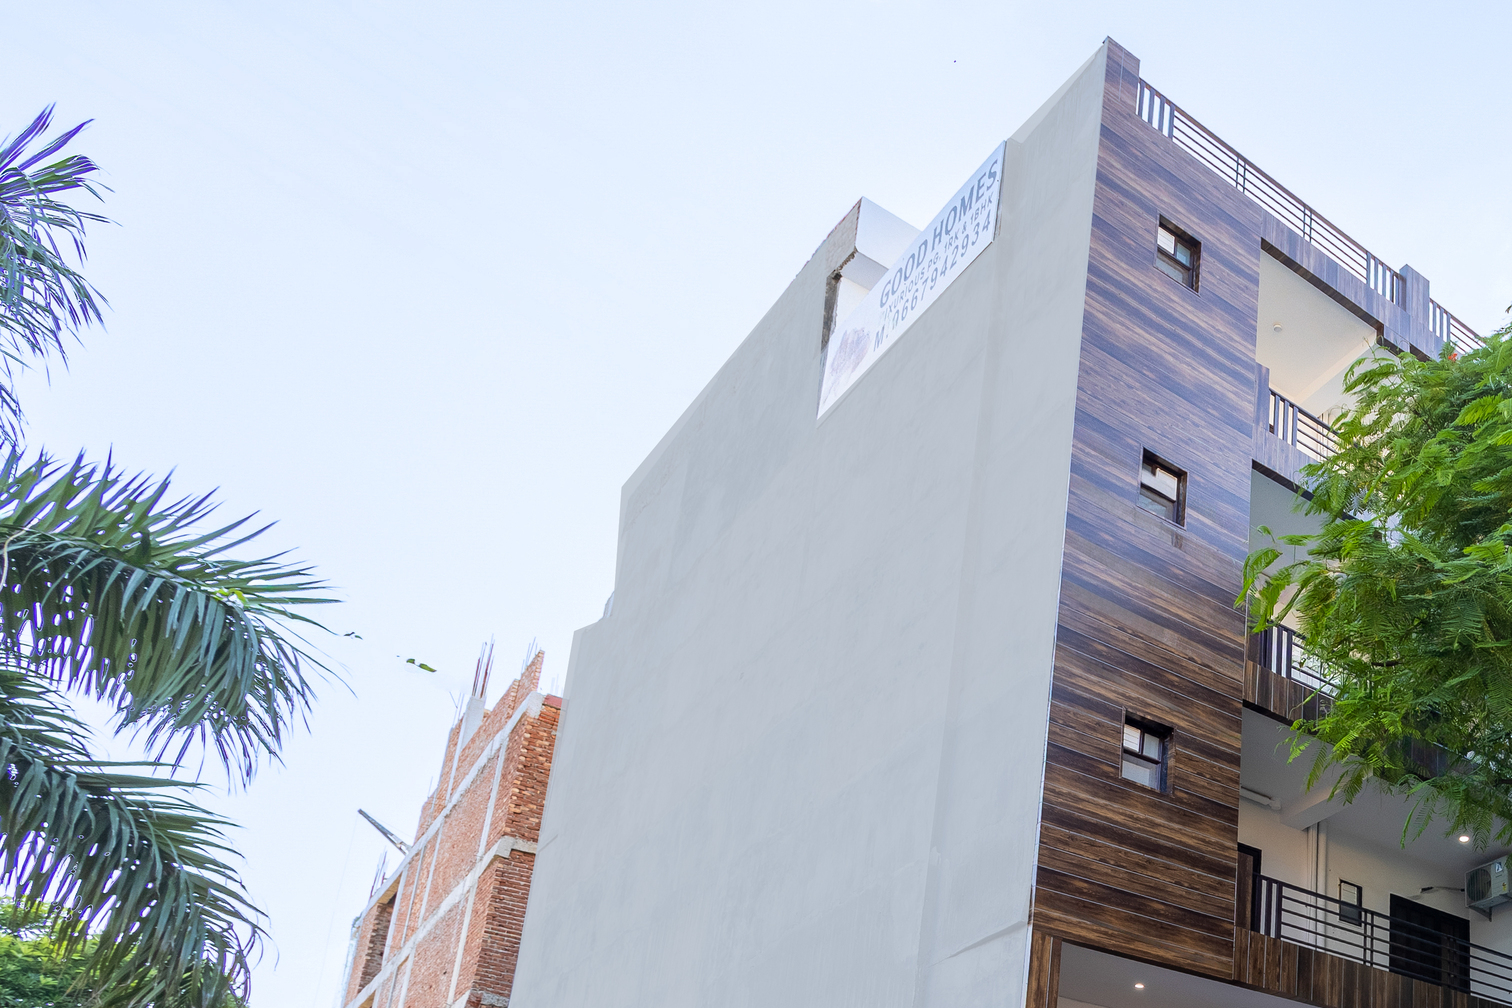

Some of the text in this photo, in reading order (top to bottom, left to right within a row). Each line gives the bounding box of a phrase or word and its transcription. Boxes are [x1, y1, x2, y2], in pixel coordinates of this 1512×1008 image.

[880, 159, 998, 309] GOOD HOMES
[962, 221, 967, 234] &
[970, 191, 994, 225] 1BHK
